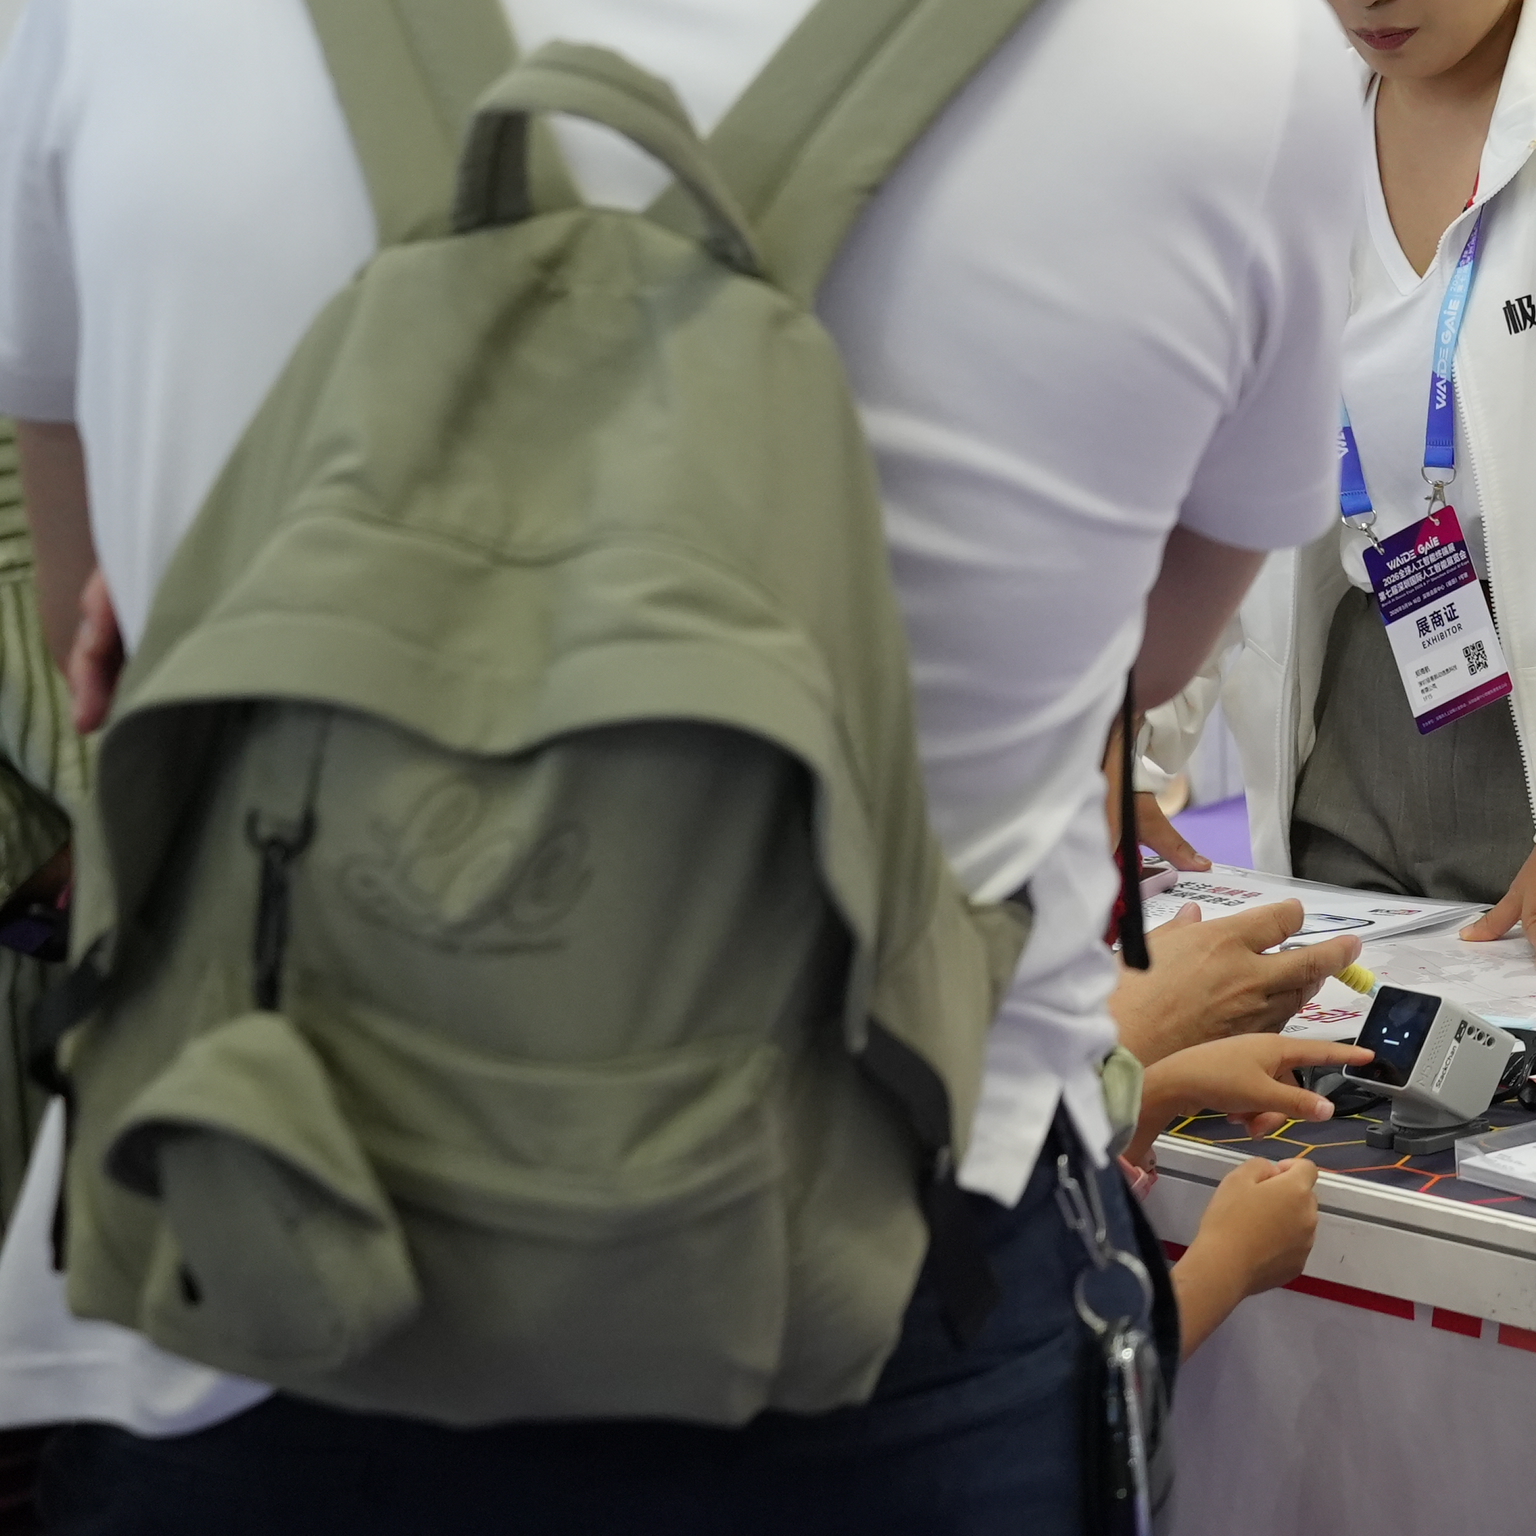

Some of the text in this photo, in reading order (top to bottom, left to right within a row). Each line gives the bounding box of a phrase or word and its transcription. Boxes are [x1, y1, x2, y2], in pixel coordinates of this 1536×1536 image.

[1415, 602, 1460, 638] 展商证
[1421, 622, 1463, 650] EXHIBITOR
